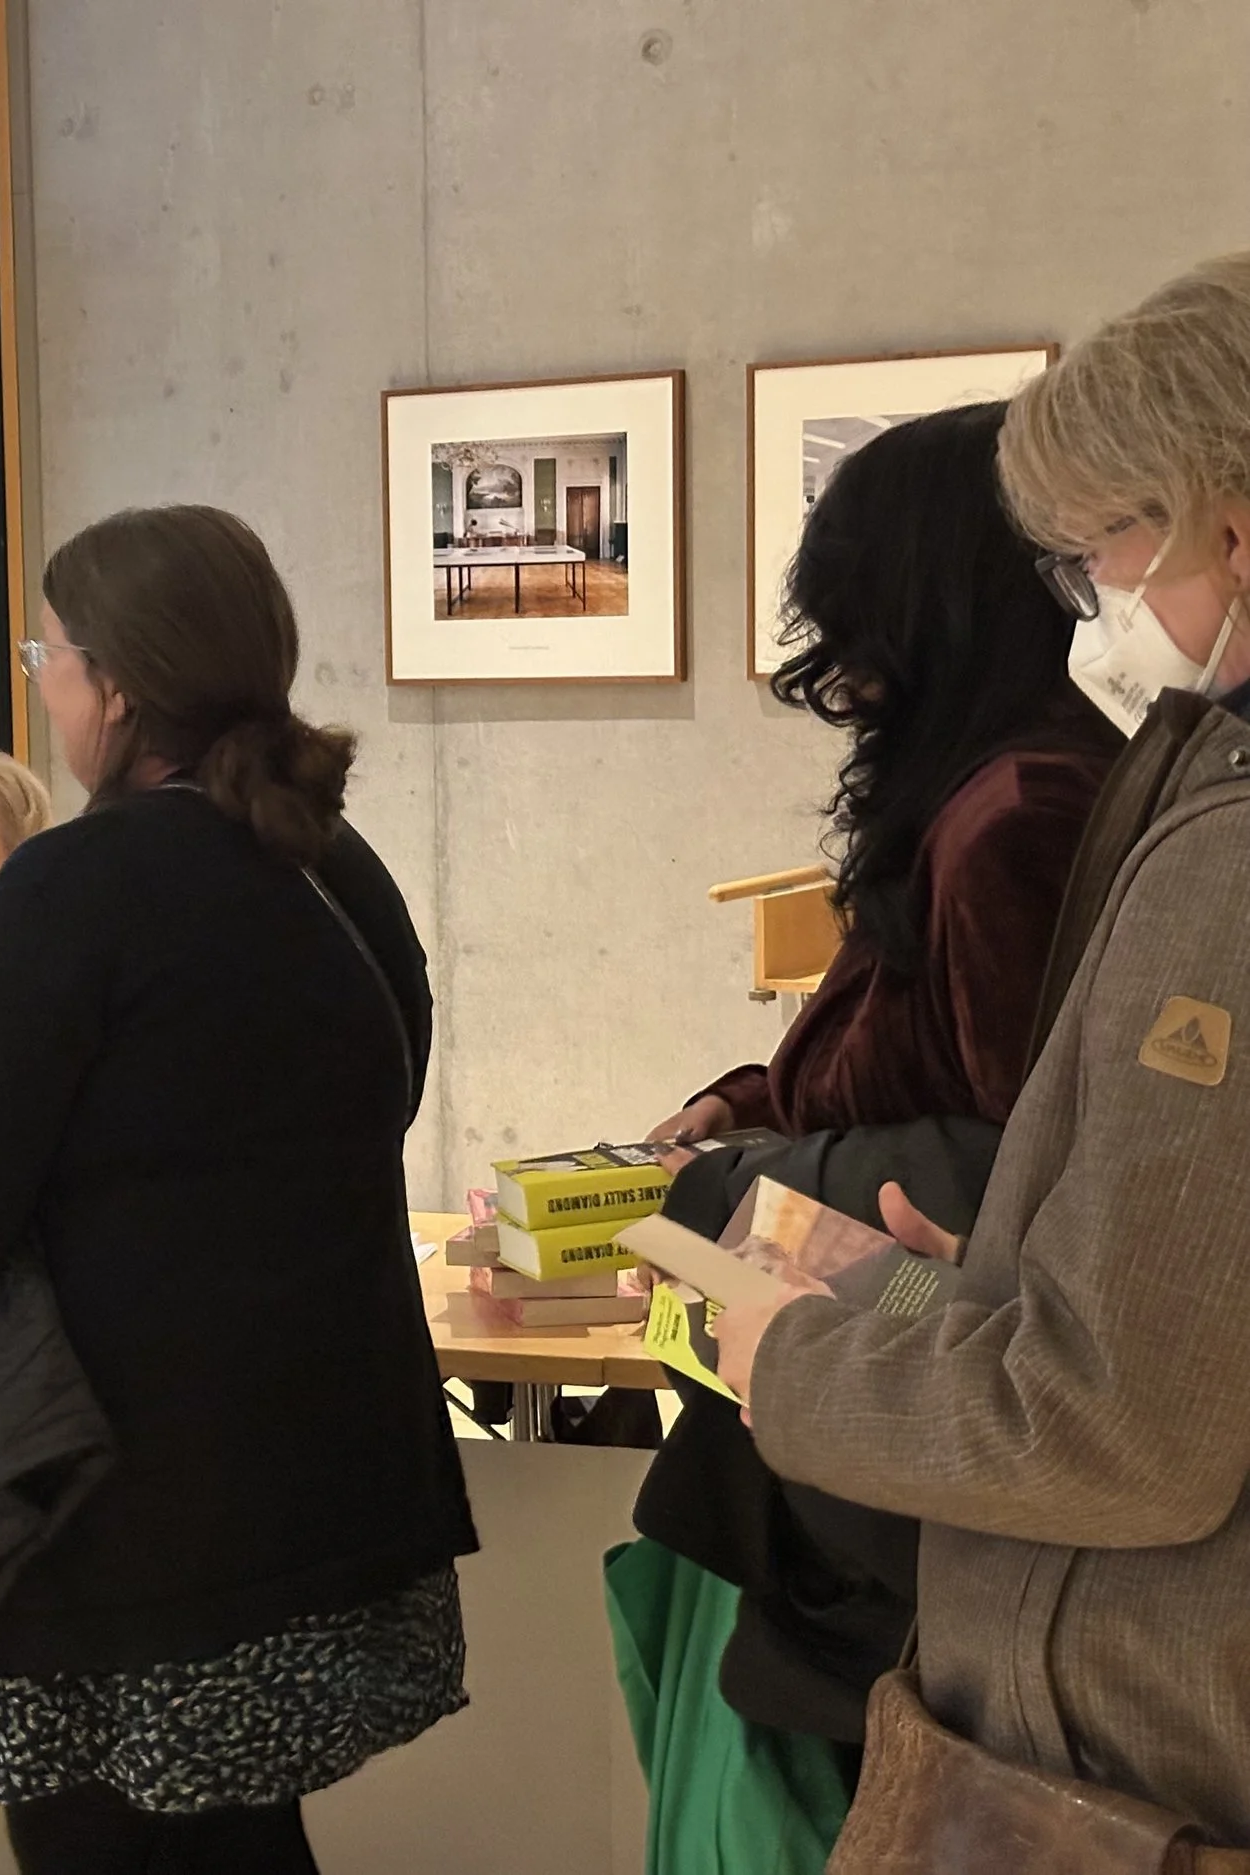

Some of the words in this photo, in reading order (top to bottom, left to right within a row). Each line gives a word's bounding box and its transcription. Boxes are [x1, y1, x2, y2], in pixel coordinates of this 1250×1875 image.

[548, 1193, 601, 1214] DIAMOND
[604, 1188, 636, 1206] SALLY
[561, 1242, 613, 1264] DIAMOND
